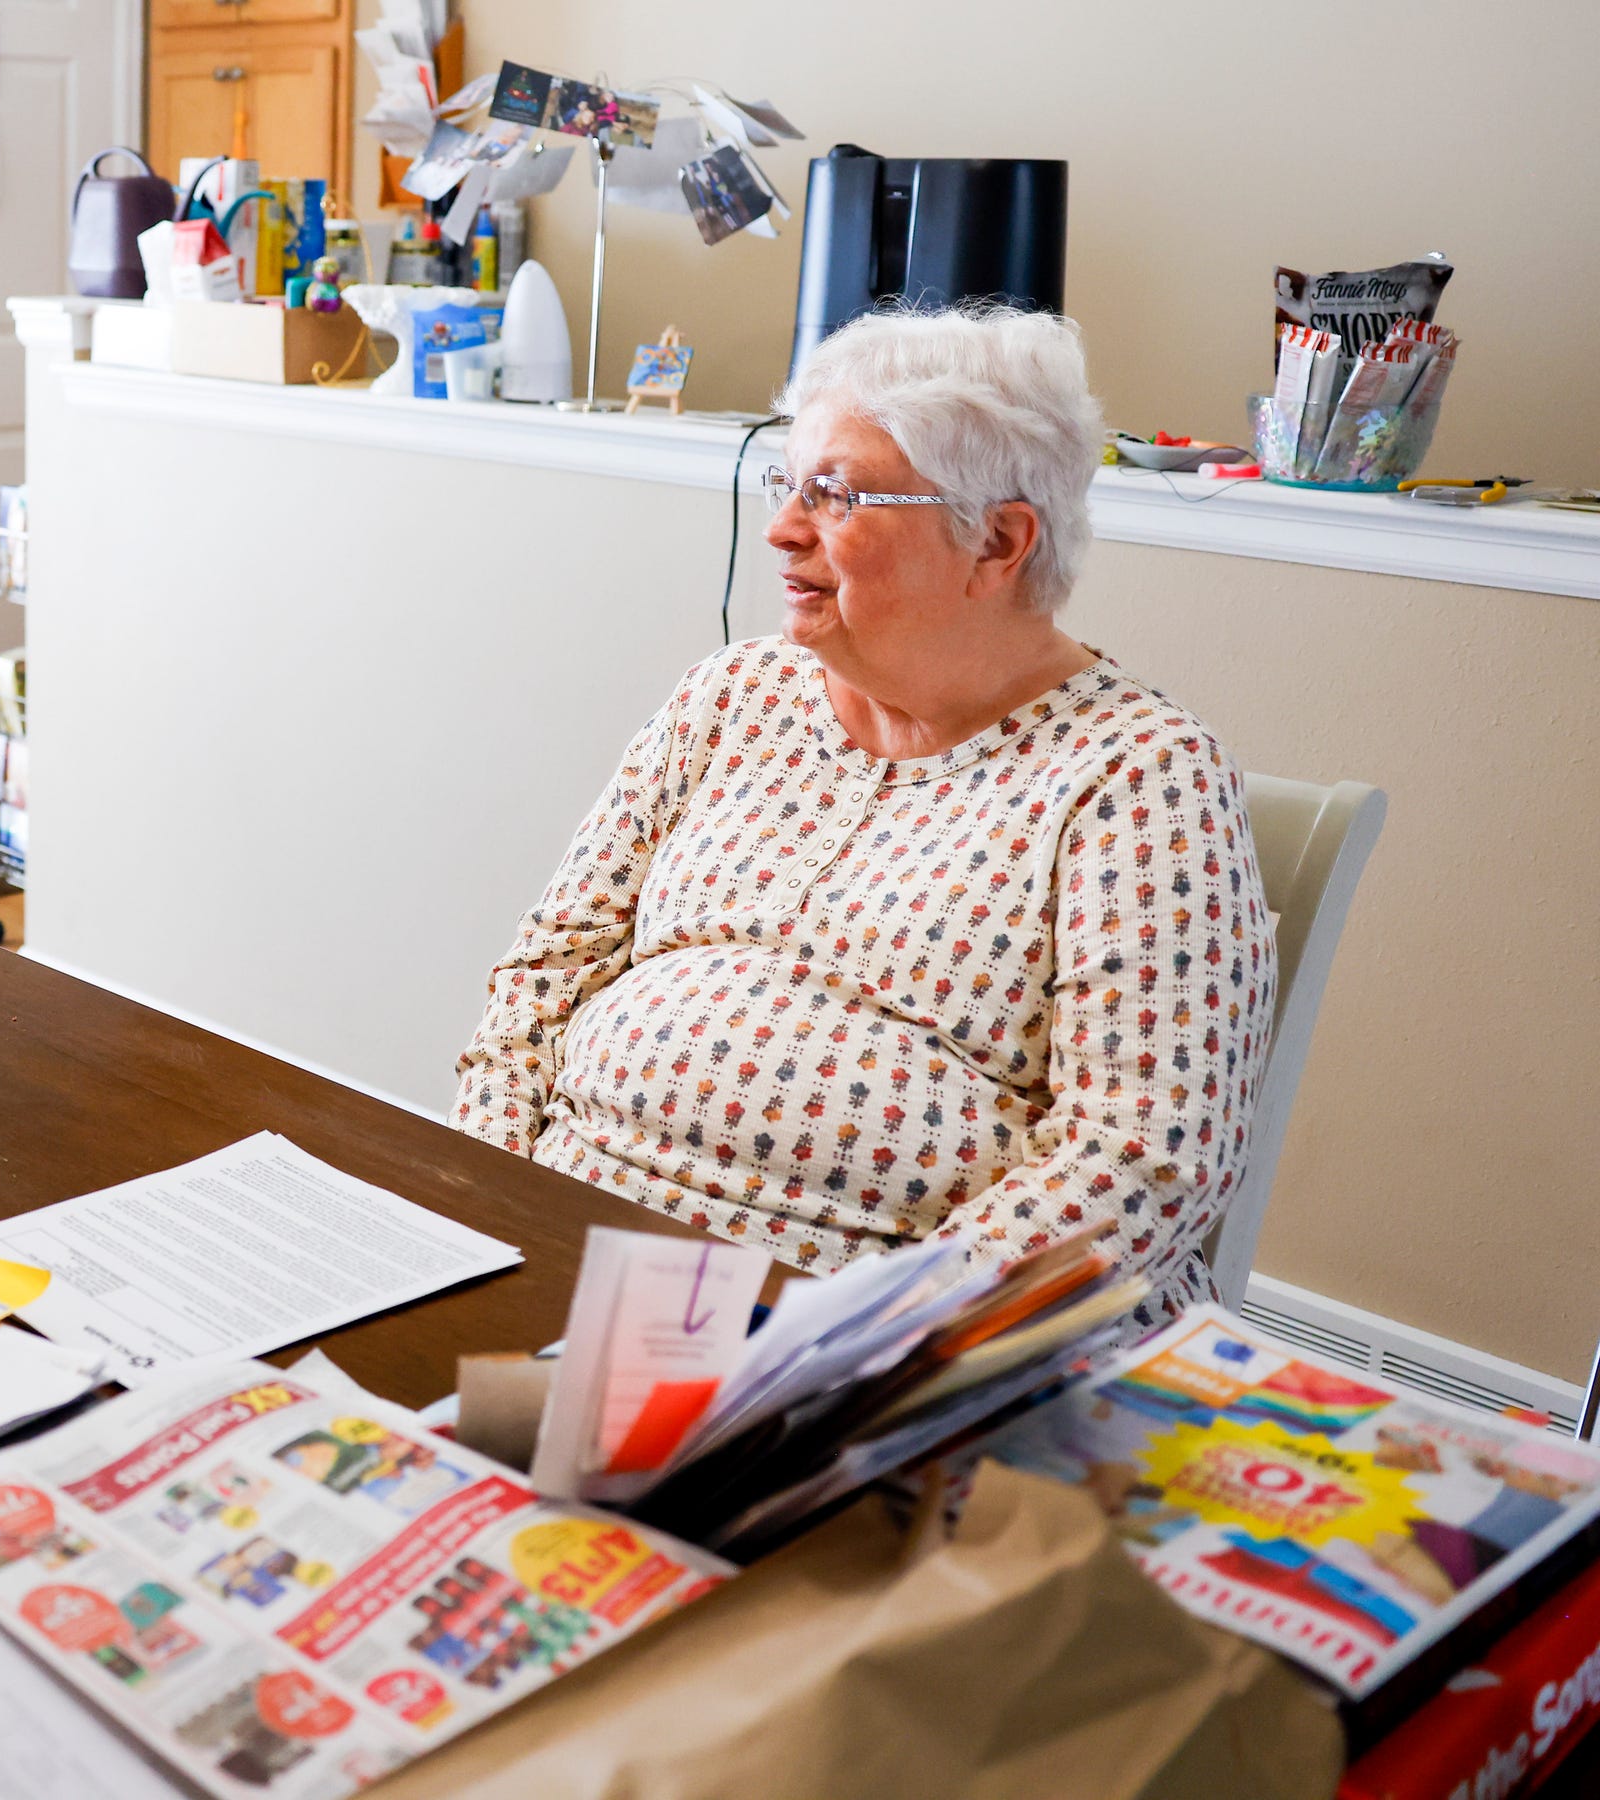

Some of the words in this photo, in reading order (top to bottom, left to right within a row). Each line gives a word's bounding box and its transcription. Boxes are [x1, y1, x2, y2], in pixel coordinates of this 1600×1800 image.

[1312, 277, 1366, 301] Fannie
[1366, 276, 1408, 304] May
[1310, 311, 1417, 358] S'MOR
[191, 1403, 253, 1441] Fuel
[113, 1430, 203, 1489] Points
